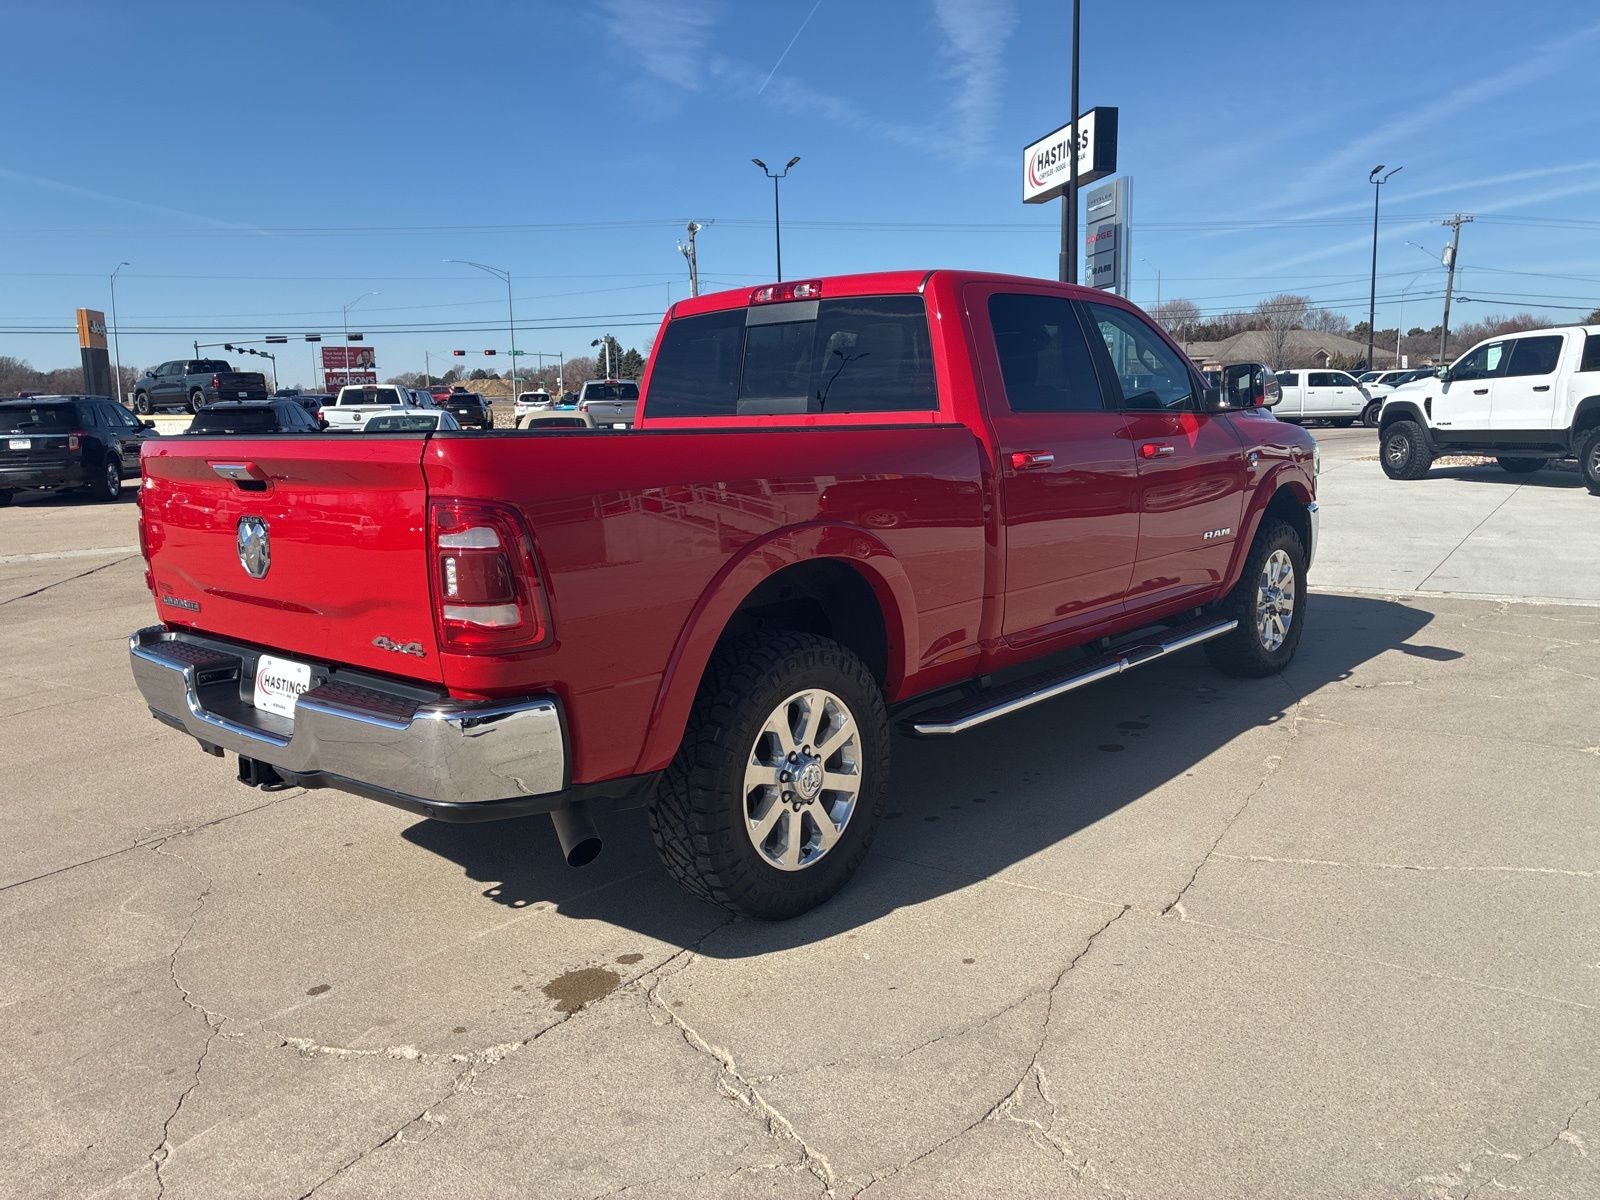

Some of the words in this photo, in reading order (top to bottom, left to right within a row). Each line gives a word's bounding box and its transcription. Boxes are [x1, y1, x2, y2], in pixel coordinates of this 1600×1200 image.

[1087, 230, 1113, 245] DODGE
[1092, 264, 1112, 276] RAM
[1203, 528, 1231, 540] RAM
[264, 674, 307, 695] HASTINGS
